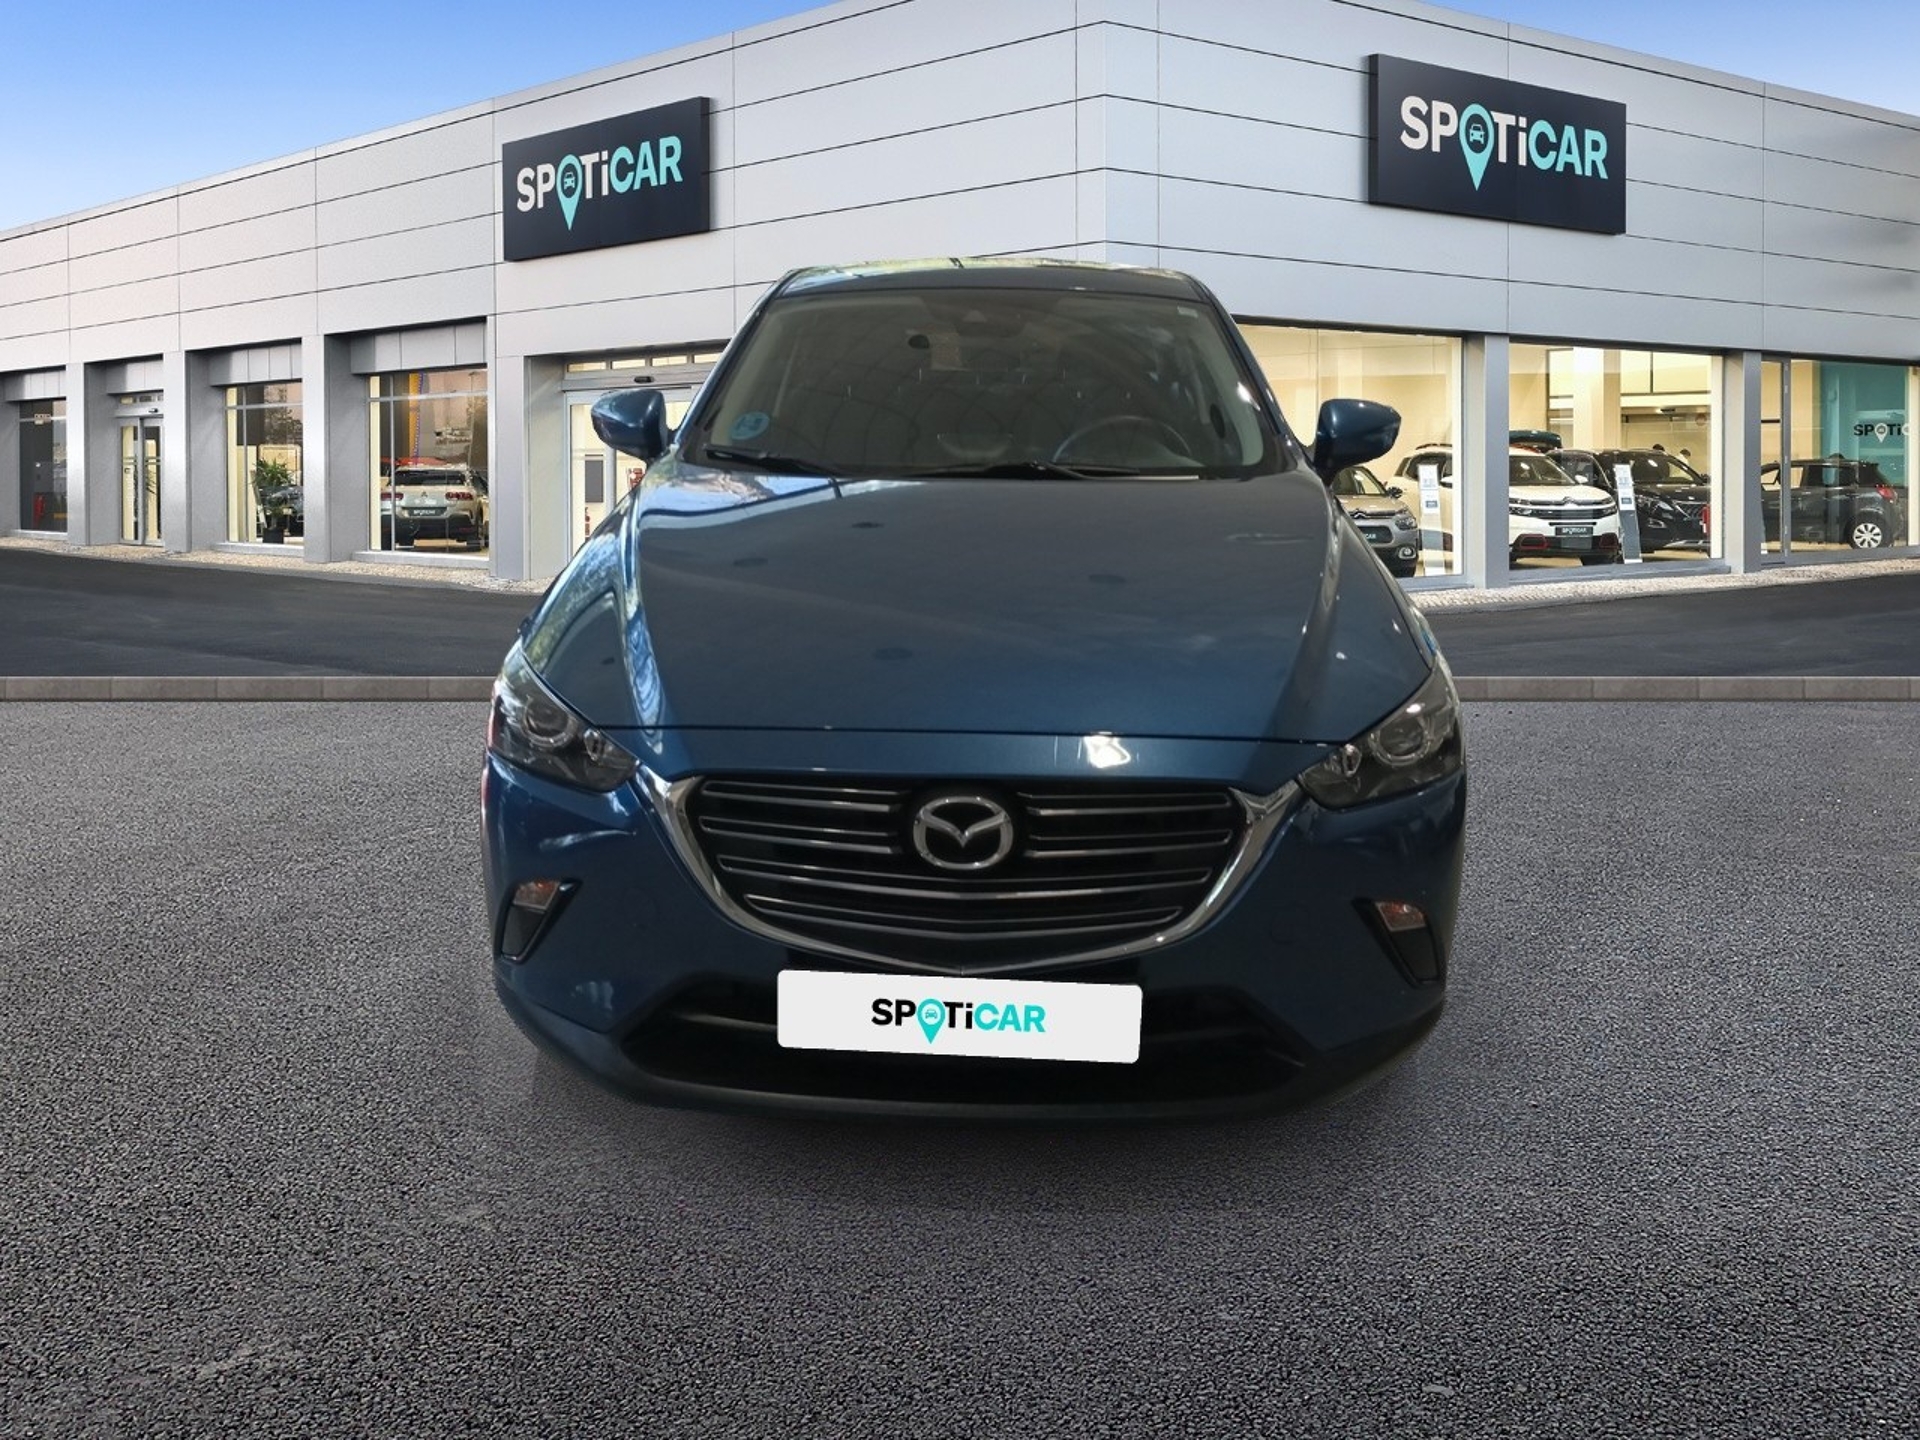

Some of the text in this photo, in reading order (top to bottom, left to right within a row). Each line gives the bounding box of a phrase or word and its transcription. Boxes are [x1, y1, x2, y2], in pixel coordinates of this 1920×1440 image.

[517, 135, 683, 231] SPOTiCAR
[1400, 96, 1608, 191] SPOTiCAR
[871, 998, 1046, 1044] SPOTiCAR
